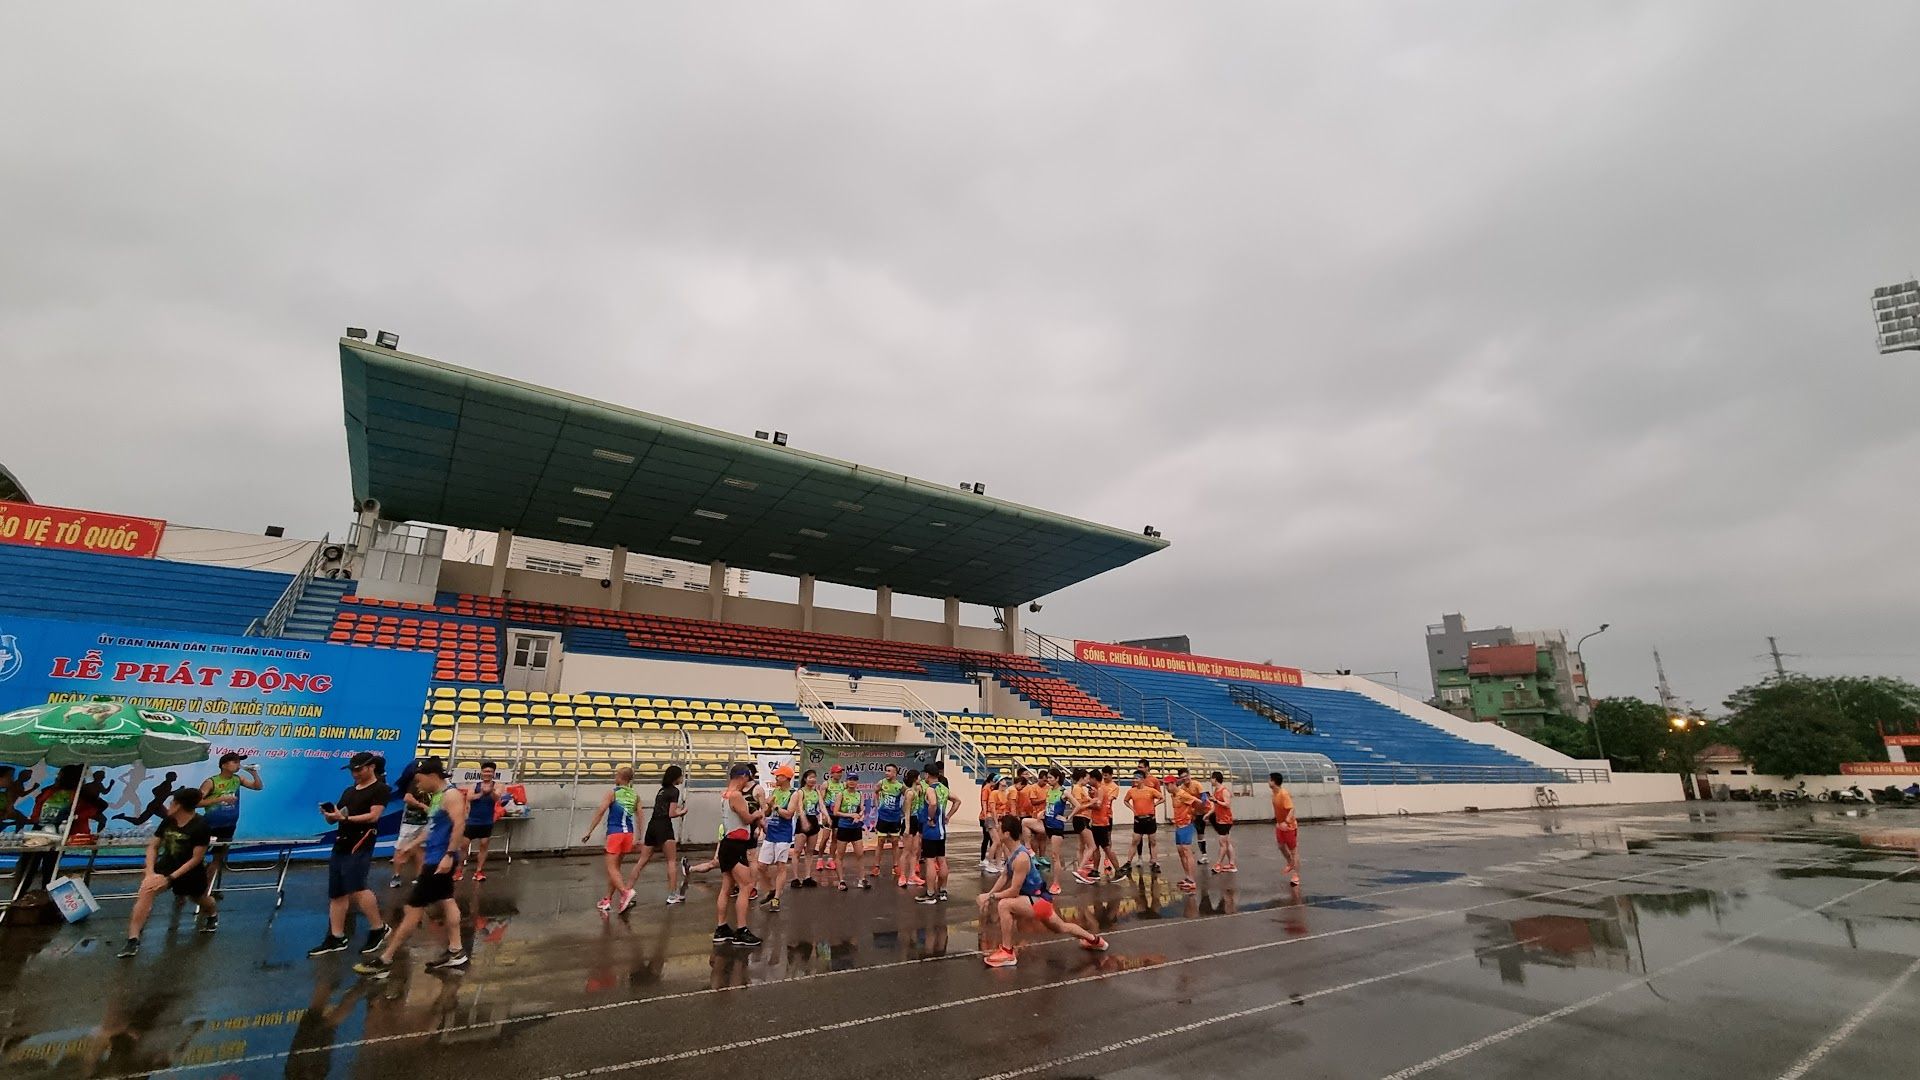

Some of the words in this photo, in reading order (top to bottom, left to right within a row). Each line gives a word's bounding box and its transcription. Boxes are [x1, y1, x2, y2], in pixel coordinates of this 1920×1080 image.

[24, 516, 52, 546] VỆ
[55, 517, 86, 545] TỔ
[84, 523, 139, 551] QUỐC
[117, 637, 144, 647] BAN
[146, 639, 180, 650] NHÂN
[182, 642, 207, 652] DÂN
[48, 650, 104, 680] LỄ
[112, 660, 223, 687] PHÁT
[228, 666, 332, 694] ĐỘNG
[1083, 646, 1107, 663] SỐNG,
[1109, 650, 1132, 665] CHIẾN
[1133, 652, 1151, 668] ĐẤU,
[1152, 656, 1165, 668] LAO
[1166, 657, 1186, 672] ĐỘNG
[1186, 660, 1196, 672] VÀ
[1197, 662, 1210, 676] HỌC
[1224, 666, 1240, 677] THEO
[128, 696, 186, 712] OLYMPIC
[189, 697, 202, 712] VÌ
[203, 697, 230, 714] SỨC
[231, 697, 264, 715] KHỎE
[266, 701, 296, 717] TOÀN
[298, 704, 323, 718] DÂN
[142, 712, 173, 722] MILO
[208, 718, 235, 736] LẦN
[236, 720, 262, 737] THỨ
[263, 724, 278, 737] 47
[280, 722, 293, 737] VÌ
[294, 722, 316, 738] HÒA
[319, 724, 347, 739] BÌNH
[348, 726, 374, 740] NĂM
[376, 728, 401, 741] 2021
